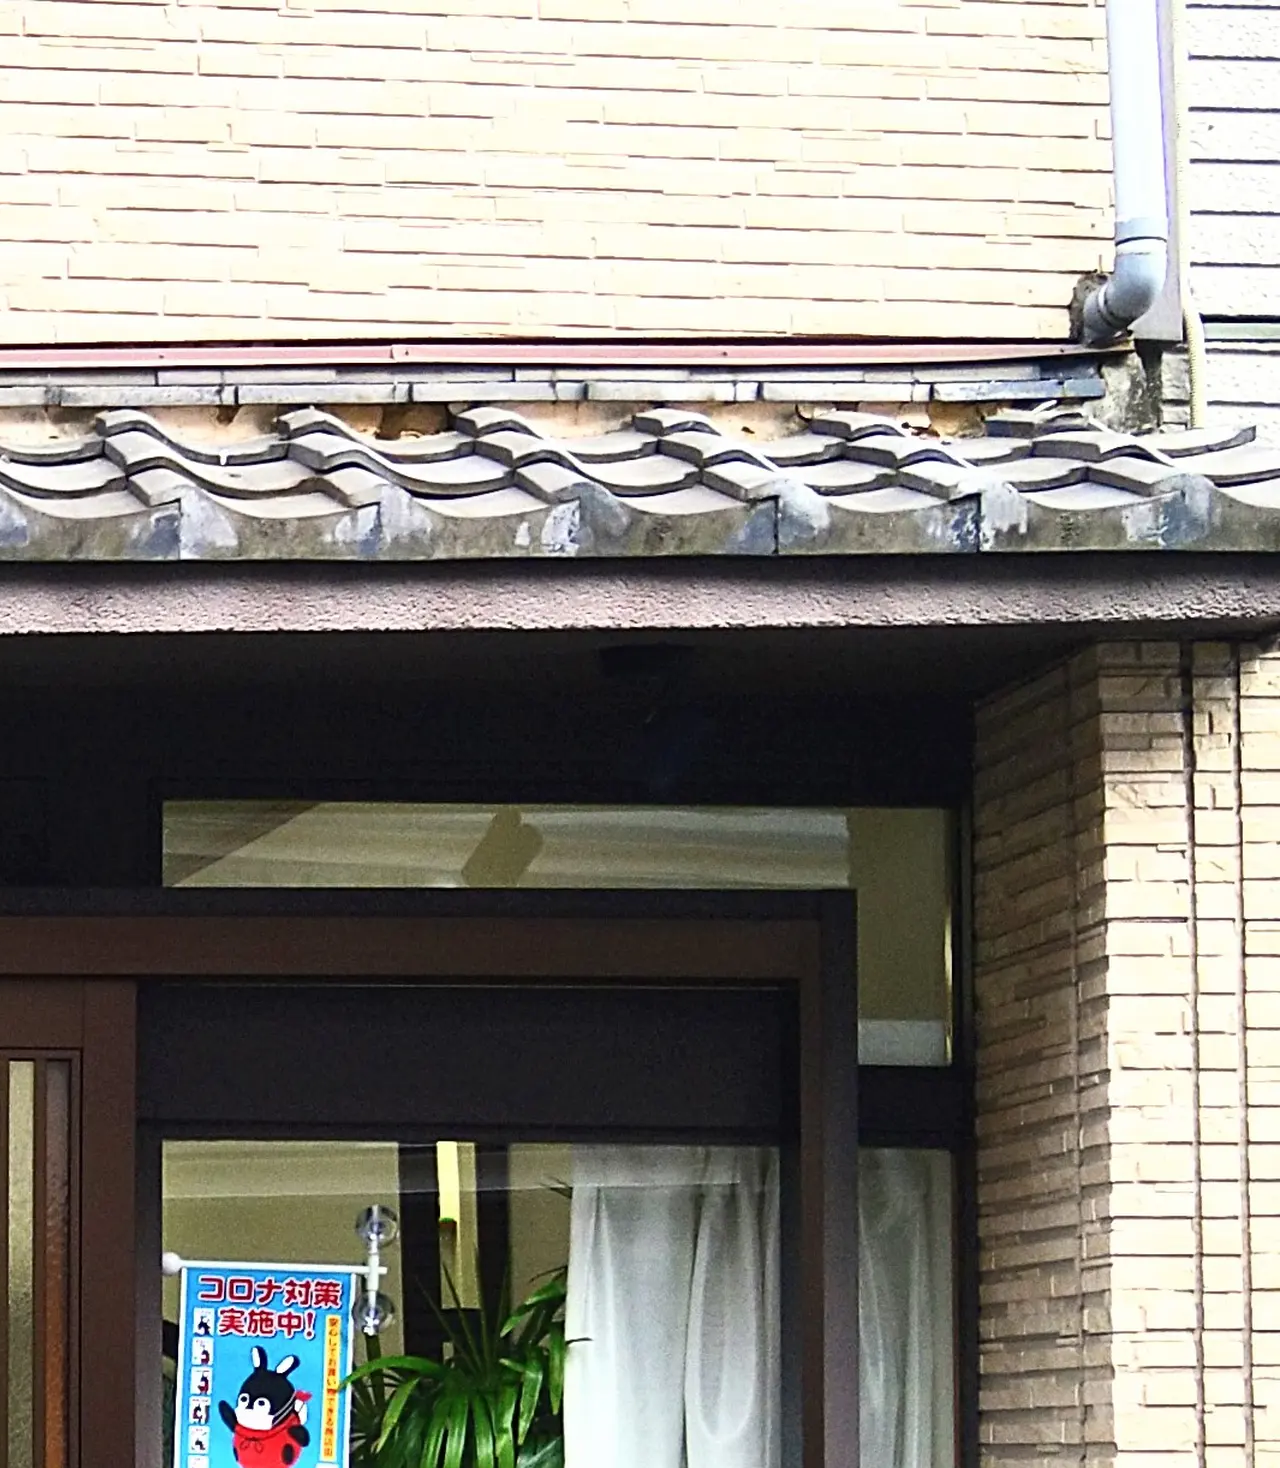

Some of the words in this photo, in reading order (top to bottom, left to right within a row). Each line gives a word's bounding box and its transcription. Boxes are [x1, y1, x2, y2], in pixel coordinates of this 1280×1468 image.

[198, 1276, 344, 1308] コロナ対策
[217, 1307, 317, 1340] 実施中!
